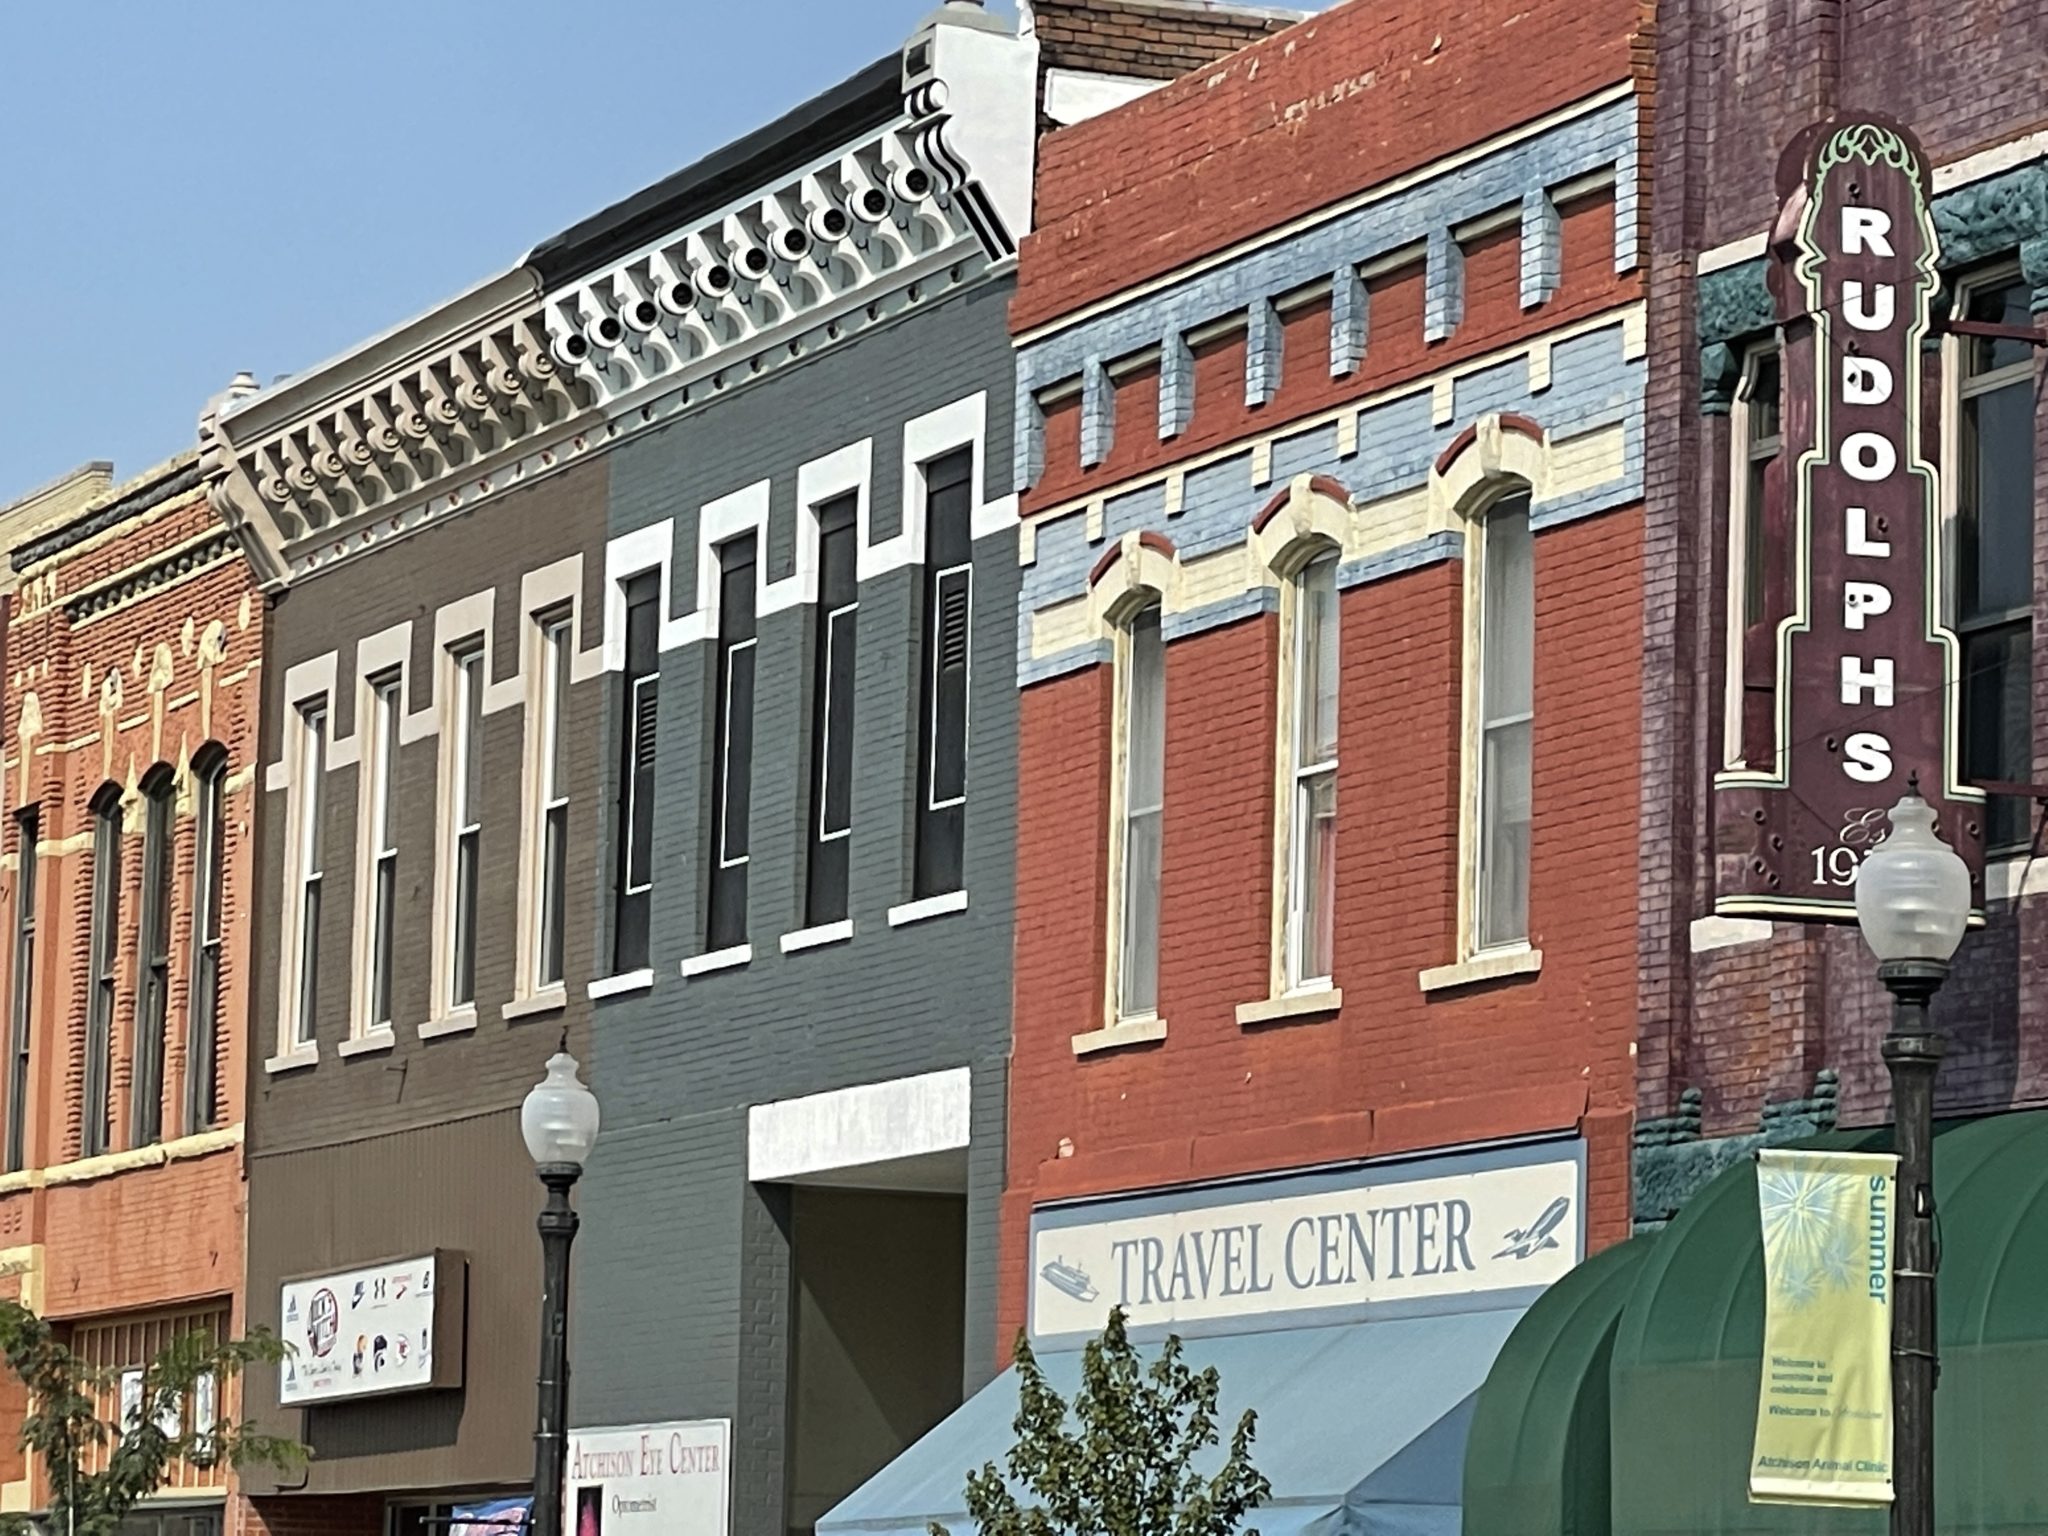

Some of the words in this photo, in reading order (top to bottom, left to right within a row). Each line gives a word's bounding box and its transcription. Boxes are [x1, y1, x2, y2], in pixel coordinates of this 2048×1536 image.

[1839, 205, 1896, 783] RUDOLPHS
[1840, 807, 1887, 844] Es
[1111, 1223, 1273, 1307] TRAVEL
[1284, 1199, 1476, 1289] CENTER
[1868, 1175, 1887, 1305] summer
[1769, 1405, 1817, 1417] Welcome
[1820, 1407, 1831, 1417] to
[1757, 1456, 1810, 1470] Atchison
[1811, 1458, 1853, 1471] Animal
[1855, 1460, 1889, 1473] Clinic
